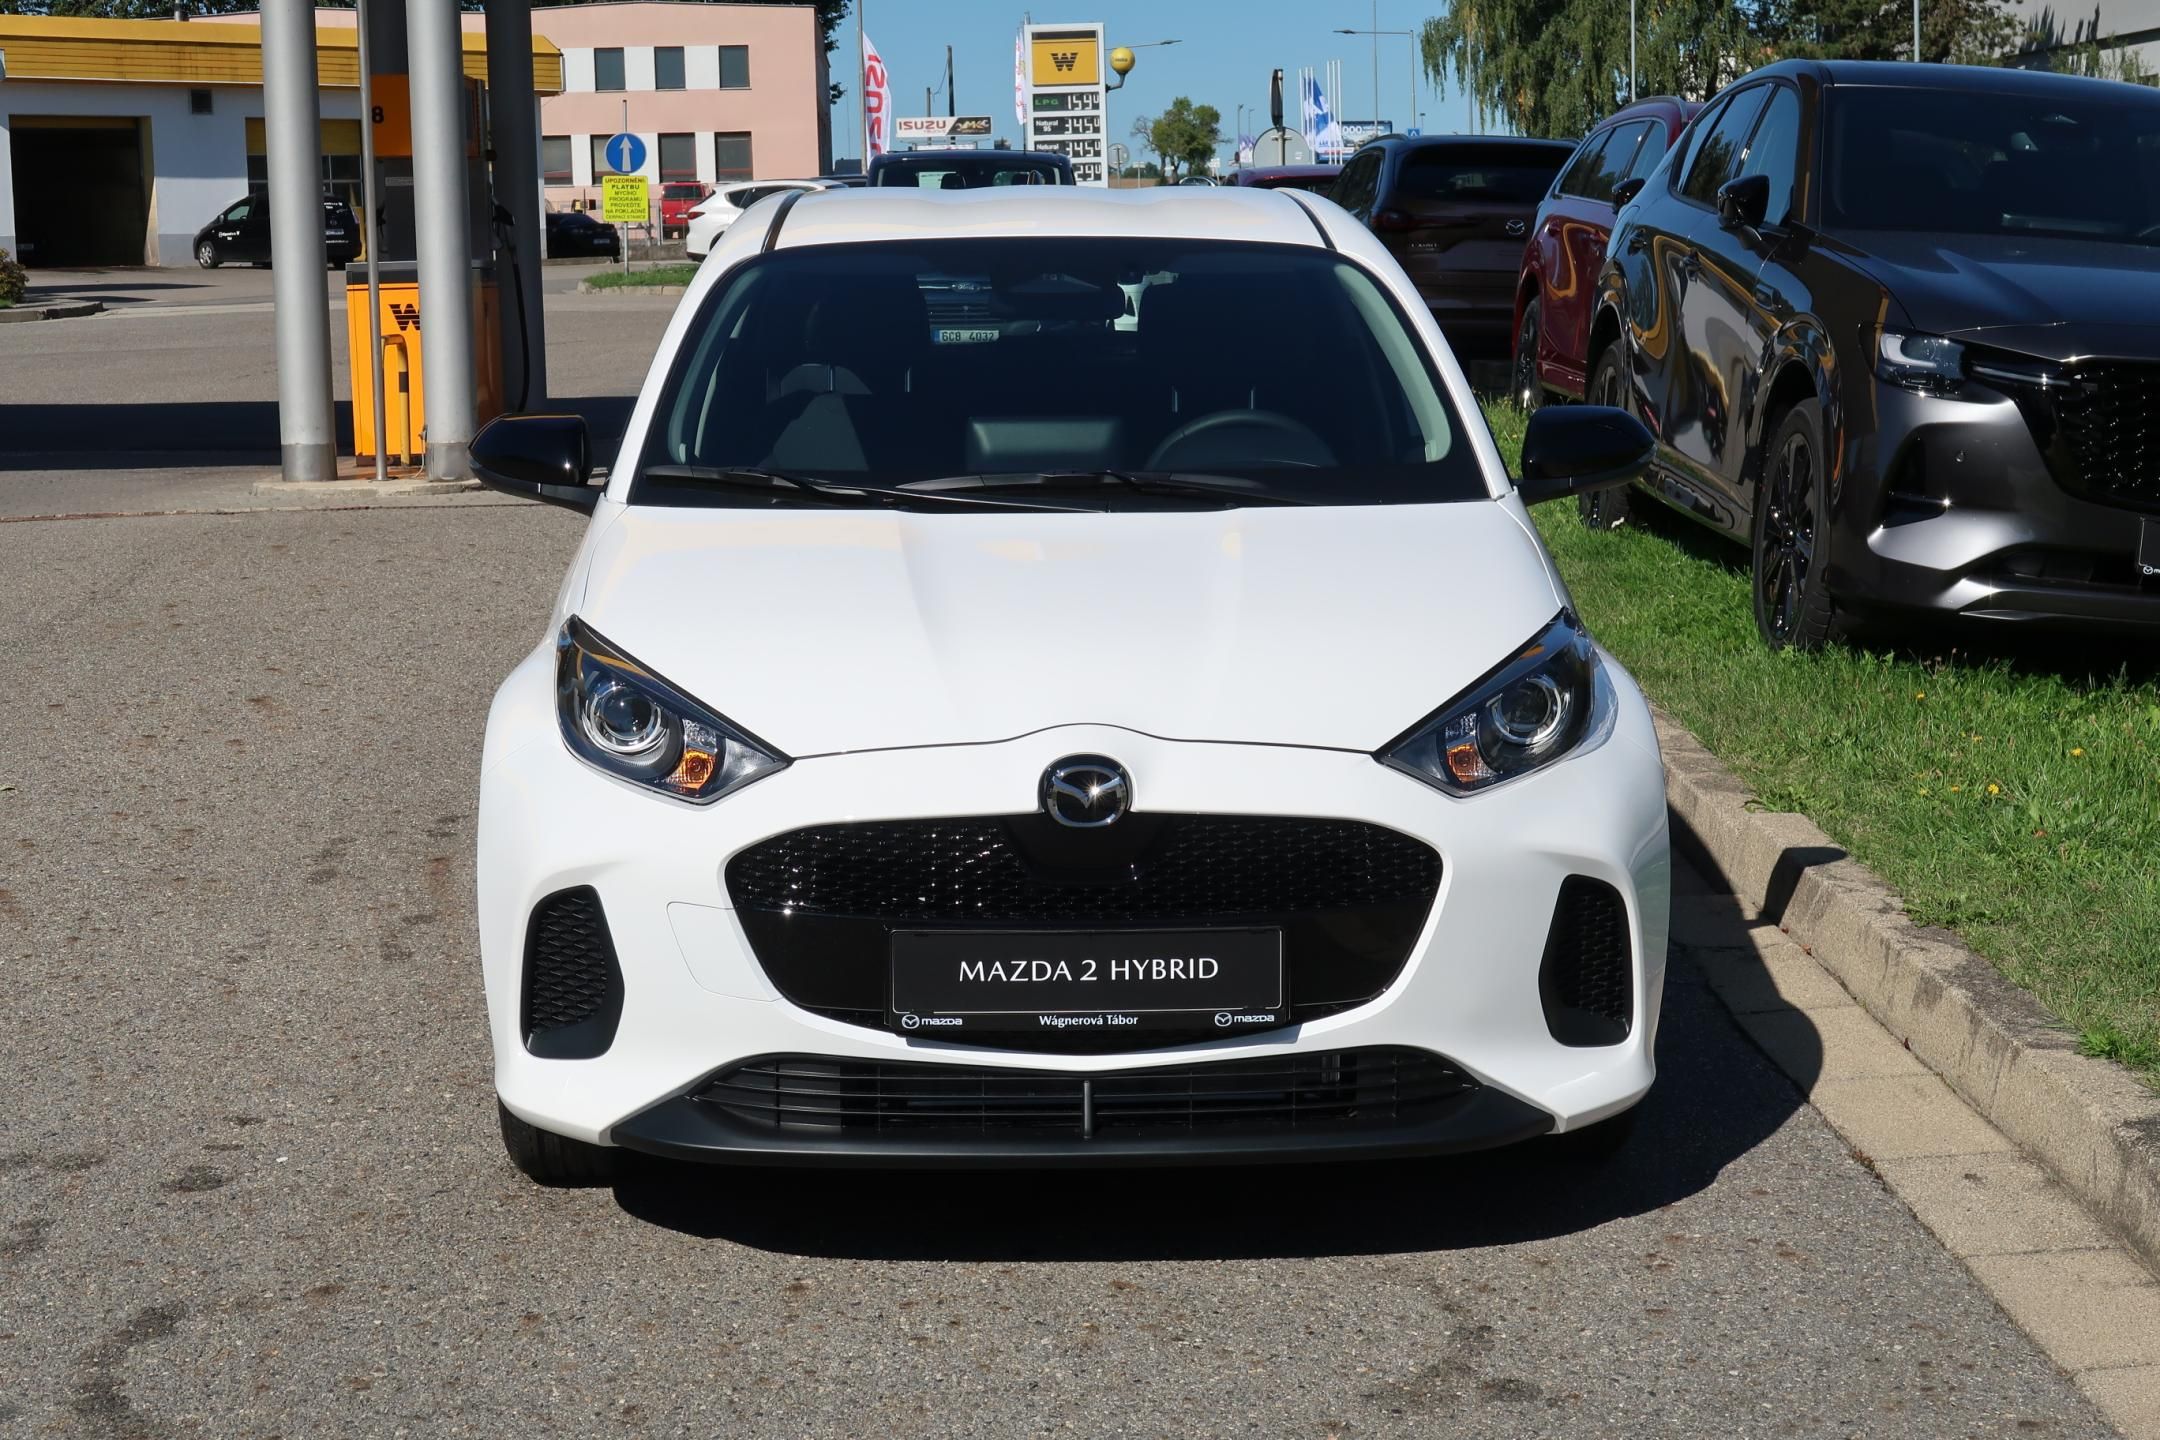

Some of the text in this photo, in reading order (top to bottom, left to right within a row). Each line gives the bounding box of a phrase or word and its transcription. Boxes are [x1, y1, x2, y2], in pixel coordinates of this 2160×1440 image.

[1035, 98, 1059, 106] LPG
[898, 120, 947, 131] ISUZU
[958, 957, 1219, 982] MAZDA 2 HYBRID
[921, 1017, 963, 1026] mazda
[1039, 1013, 1139, 1028] Wágnerová Tábor
[1234, 1014, 1275, 1023] mazda
